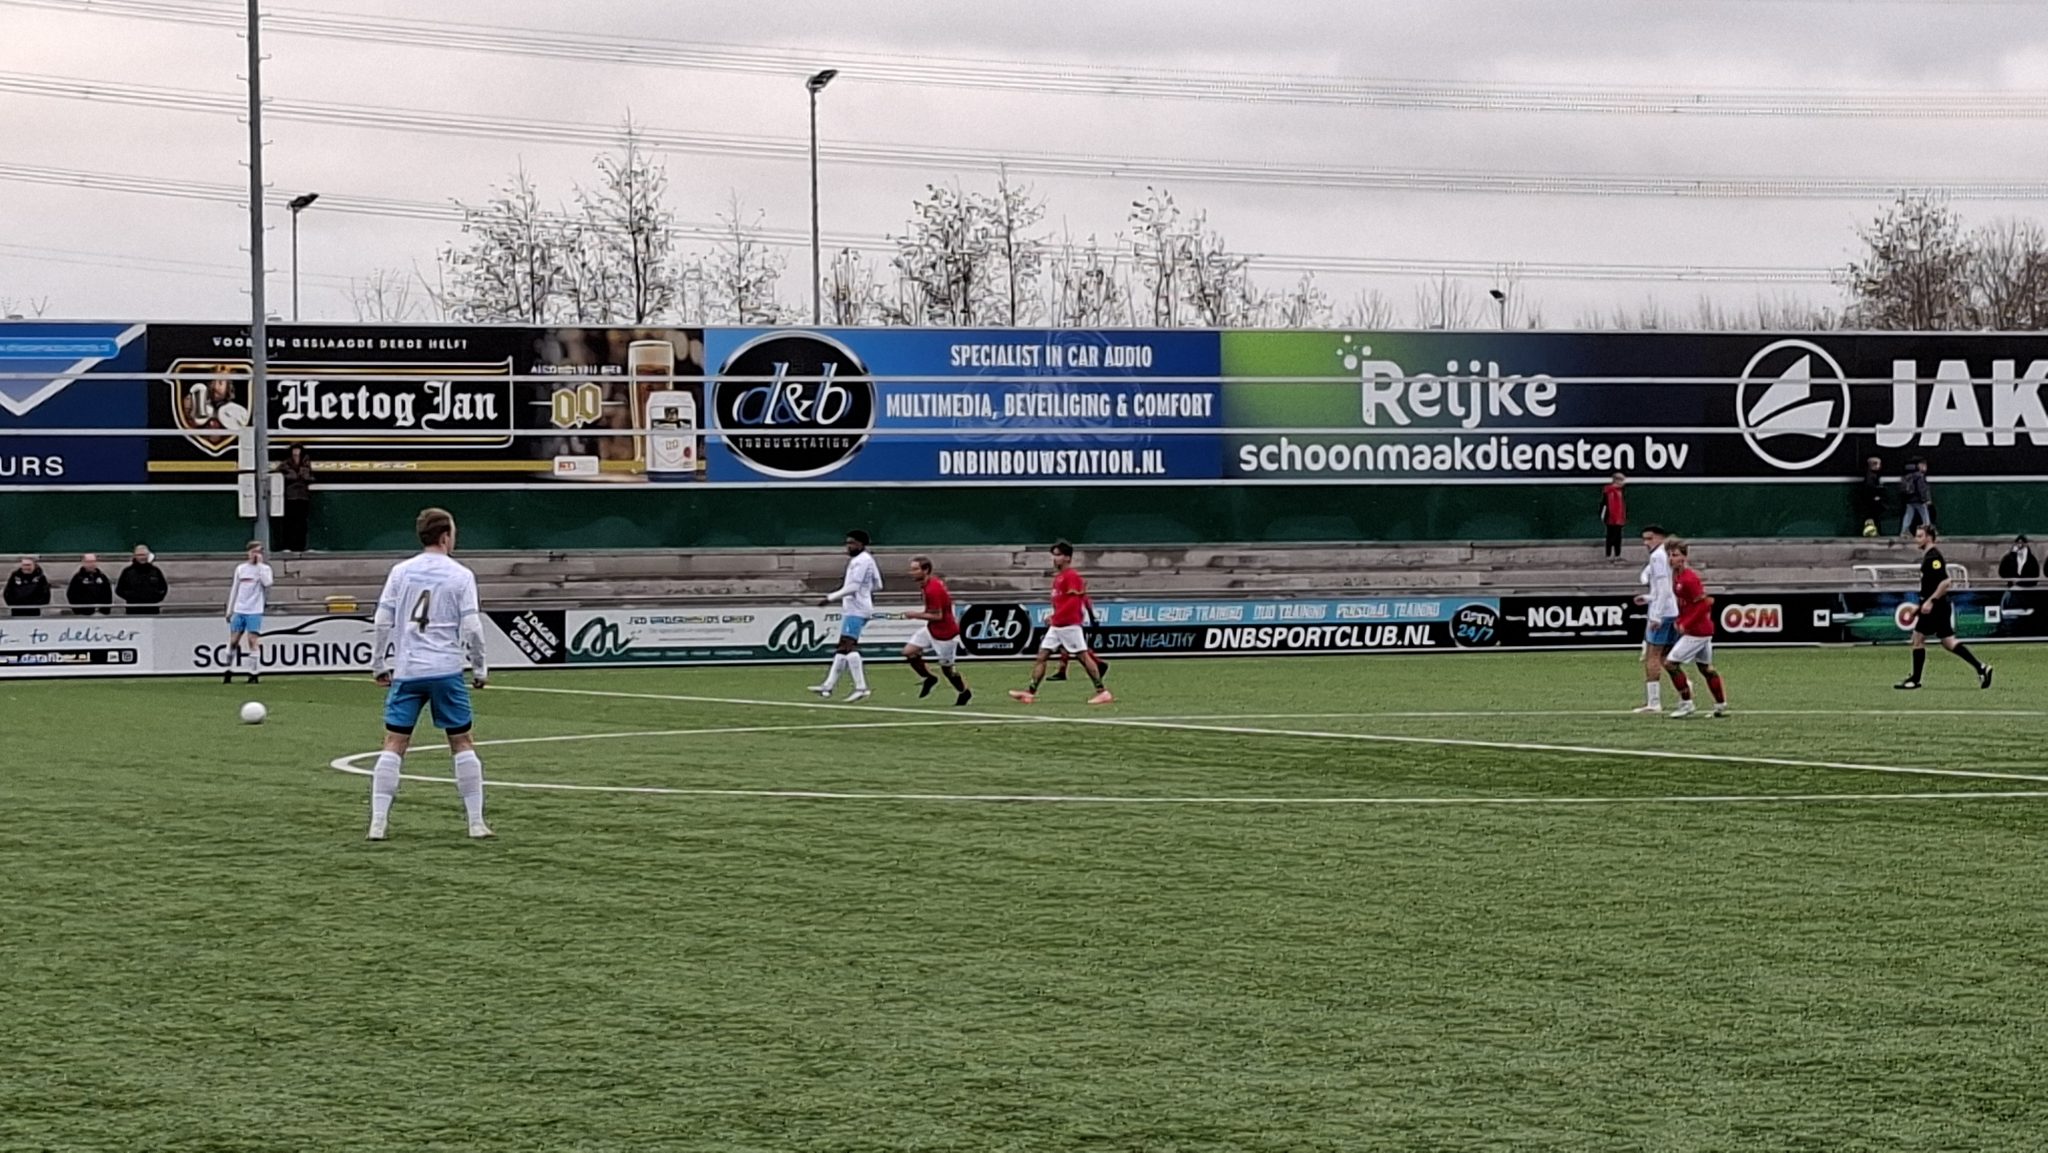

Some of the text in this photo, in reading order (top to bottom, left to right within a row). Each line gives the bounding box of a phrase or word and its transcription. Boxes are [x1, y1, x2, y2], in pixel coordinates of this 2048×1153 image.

[380, 339, 422, 349] DERDE
[950, 345, 1153, 367] SPECIALIST IN CAR AUDIO
[277, 380, 498, 431] Hertog Jan
[733, 361, 851, 425] d&b
[1361, 359, 1557, 429] Reijke
[886, 394, 1213, 420] MULTIMEDIA, BEVEILIGING & COMFORT
[938, 450, 1166, 475] DNBINBOUWSTATION.NL
[1239, 436, 1689, 471] schoonmaakdiensten bv
[410, 589, 430, 634] 4
[1724, 608, 1780, 628] OSM
[58, 627, 140, 643] deliver
[965, 609, 1023, 640] d&b
[1204, 624, 1436, 649] DNBSPORTCLUB.NL
[1457, 624, 1494, 643] 24/7
[1140, 632, 1196, 648] HEALTHY
